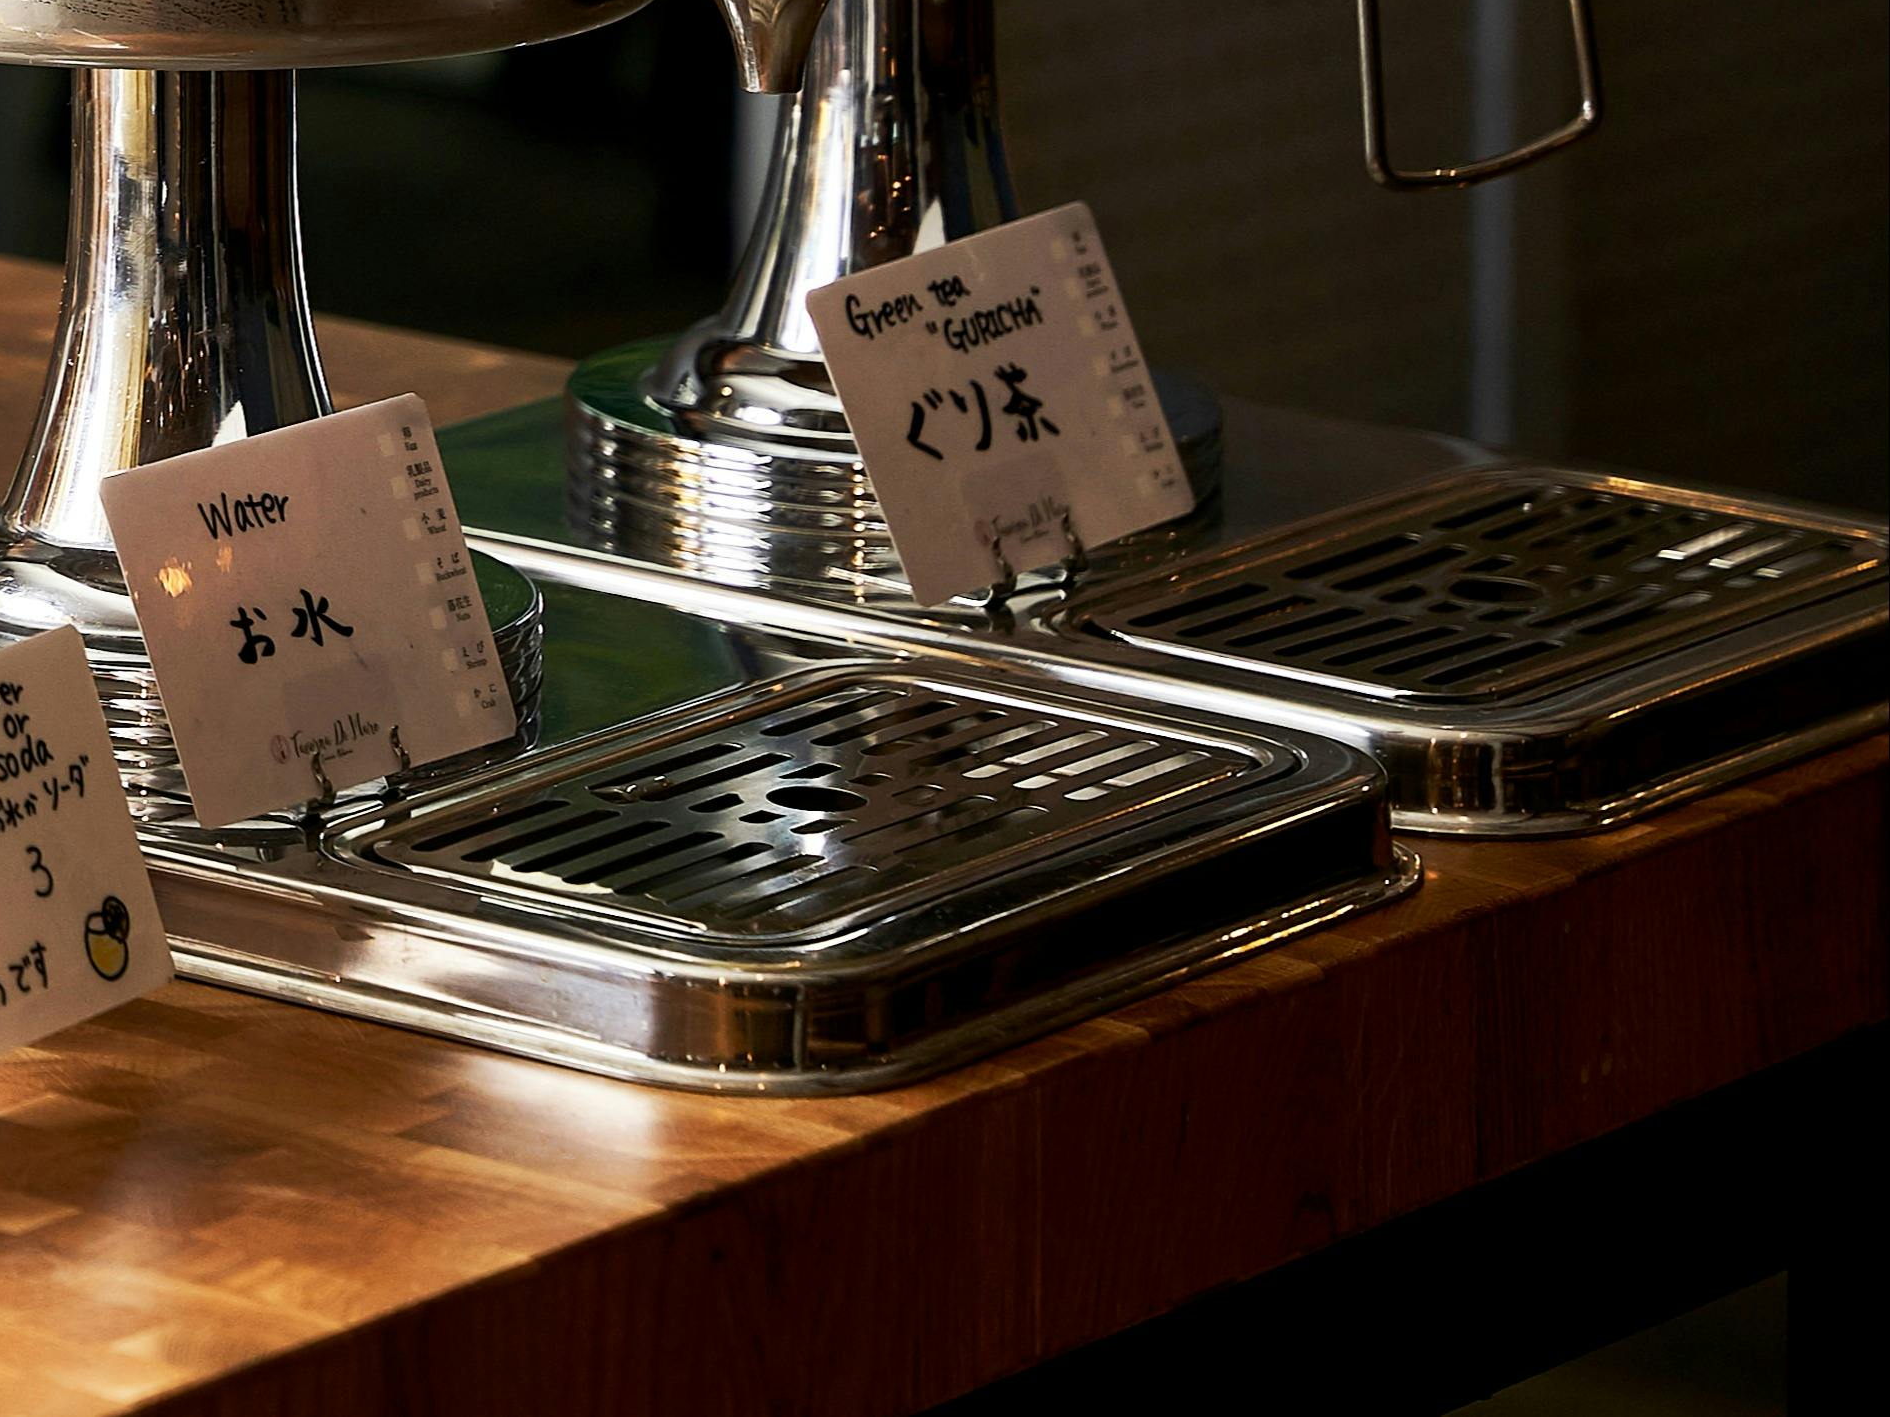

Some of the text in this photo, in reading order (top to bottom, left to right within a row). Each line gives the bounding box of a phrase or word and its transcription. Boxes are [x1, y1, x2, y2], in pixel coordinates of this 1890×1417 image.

[844, 274, 972, 341] Green tea
[905, 361, 1061, 460] ぐり茶
[197, 491, 290, 540] Water
[229, 588, 355, 665] お水
[2, 712, 30, 740] or
[25, 844, 55, 898] 3
